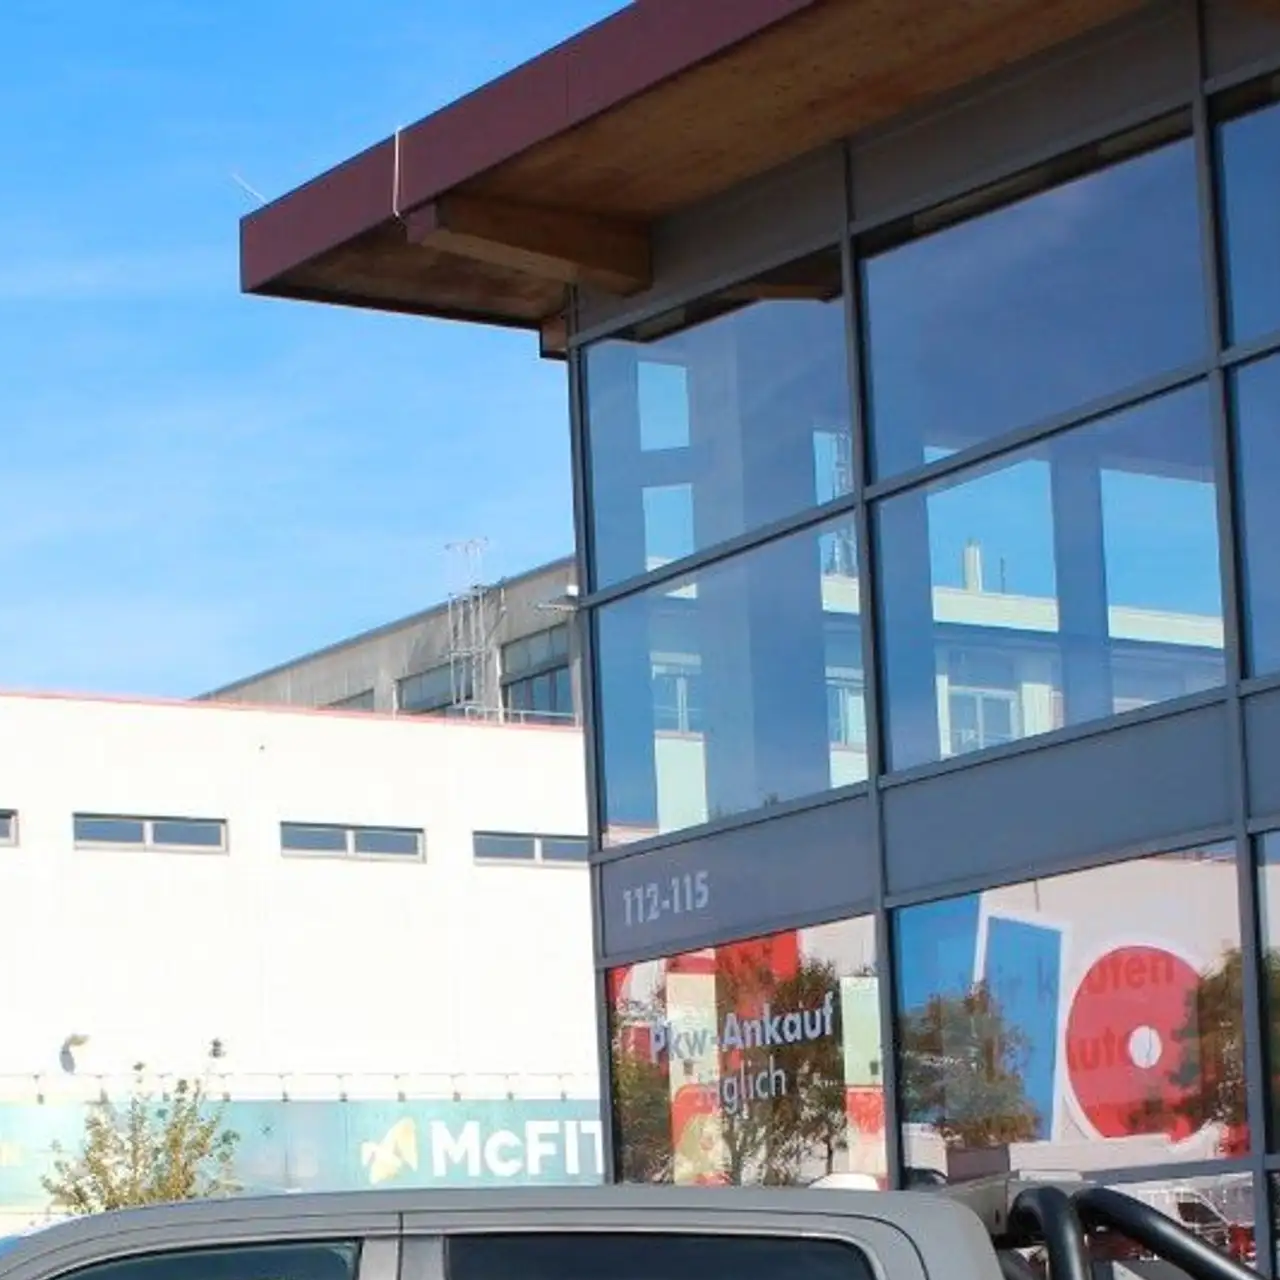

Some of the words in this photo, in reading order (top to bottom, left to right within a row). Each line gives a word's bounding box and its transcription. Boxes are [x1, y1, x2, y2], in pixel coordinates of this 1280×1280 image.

[622, 870, 710, 926] 112-115
[649, 990, 834, 1063] Pkw-Ankauf
[431, 1120, 603, 1177] McFIT
